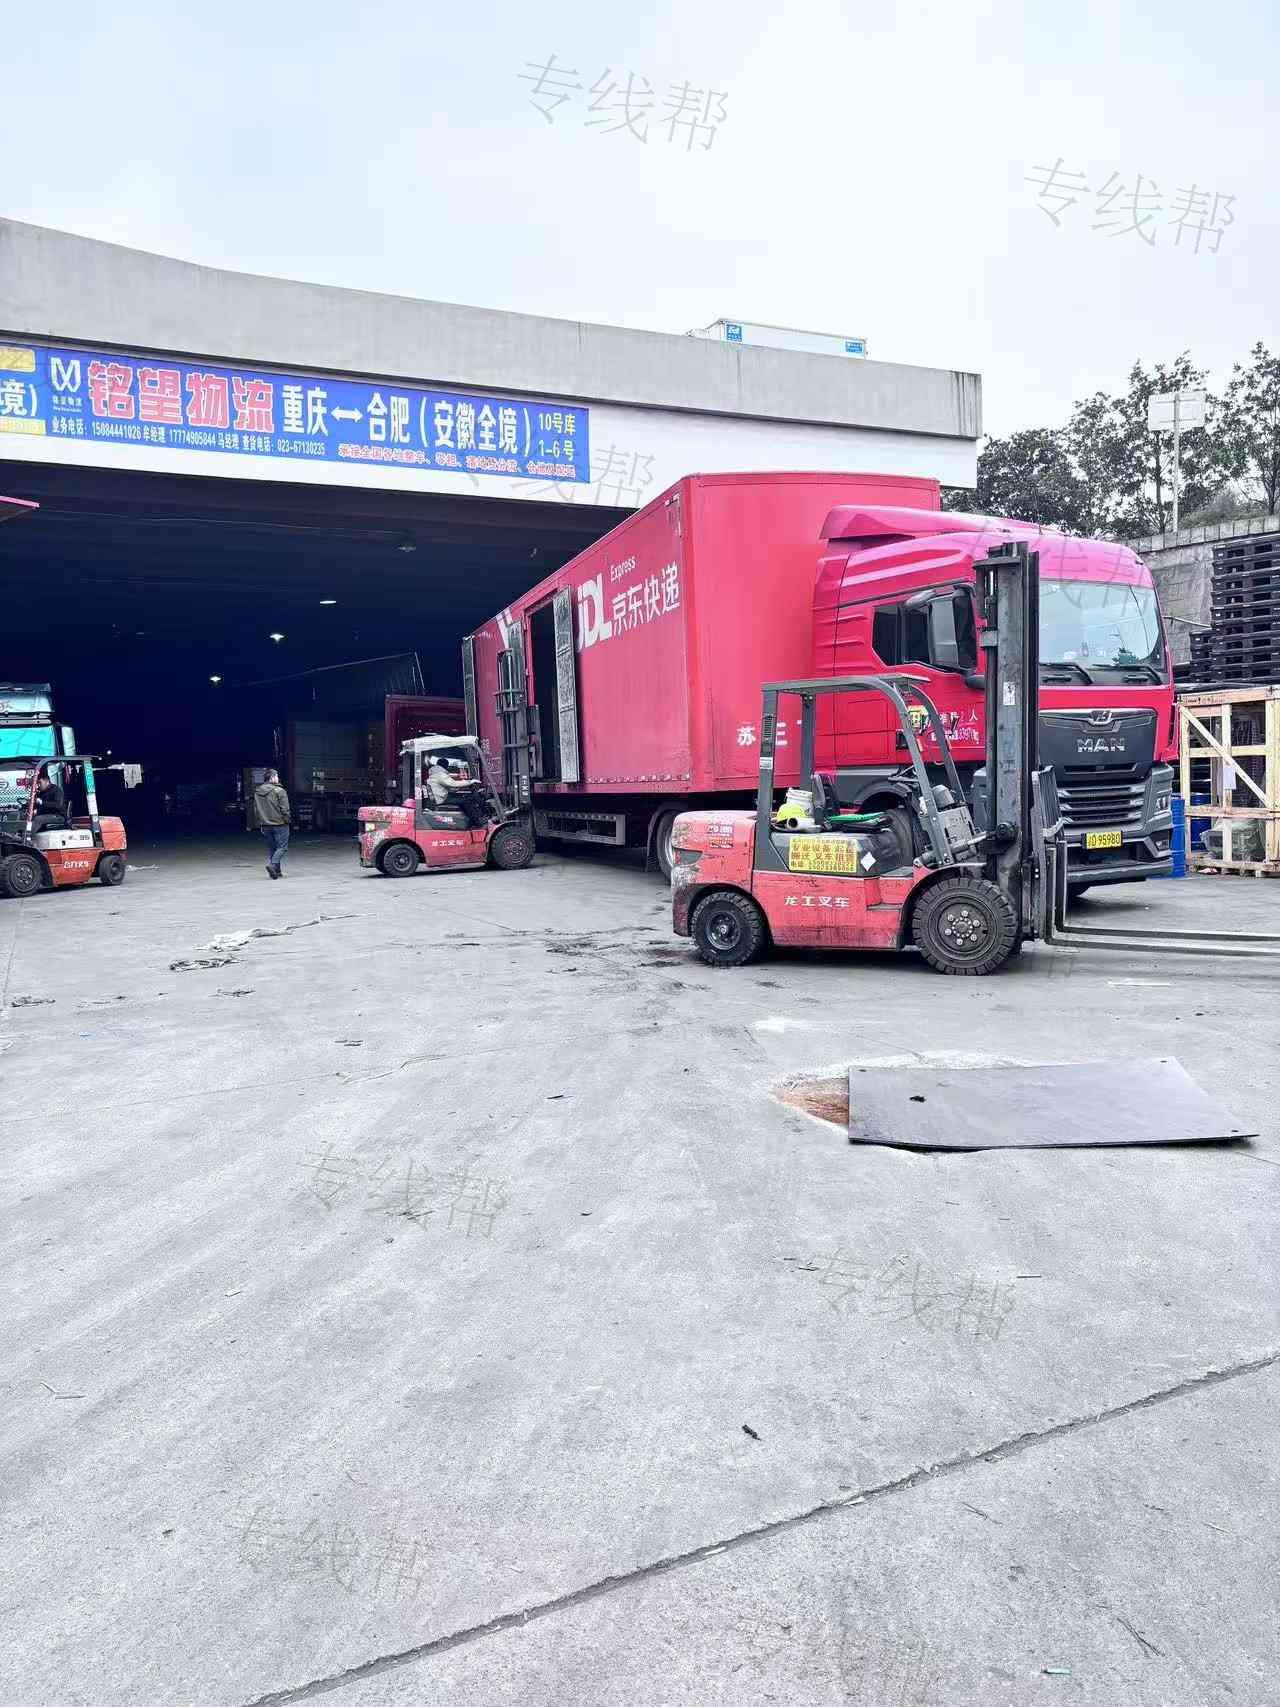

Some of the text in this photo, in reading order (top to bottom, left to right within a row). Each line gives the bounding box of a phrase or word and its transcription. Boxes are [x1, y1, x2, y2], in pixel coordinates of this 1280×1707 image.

[87, 360, 275, 433] 铭望物流
[282, 384, 328, 437] 重庆
[538, 412, 576, 436] 10号库
[610, 556, 636, 583] Express
[611, 560, 680, 636] 京东快递
[1077, 737, 1126, 752] MAN
[784, 894, 850, 907] 龙工叉车
